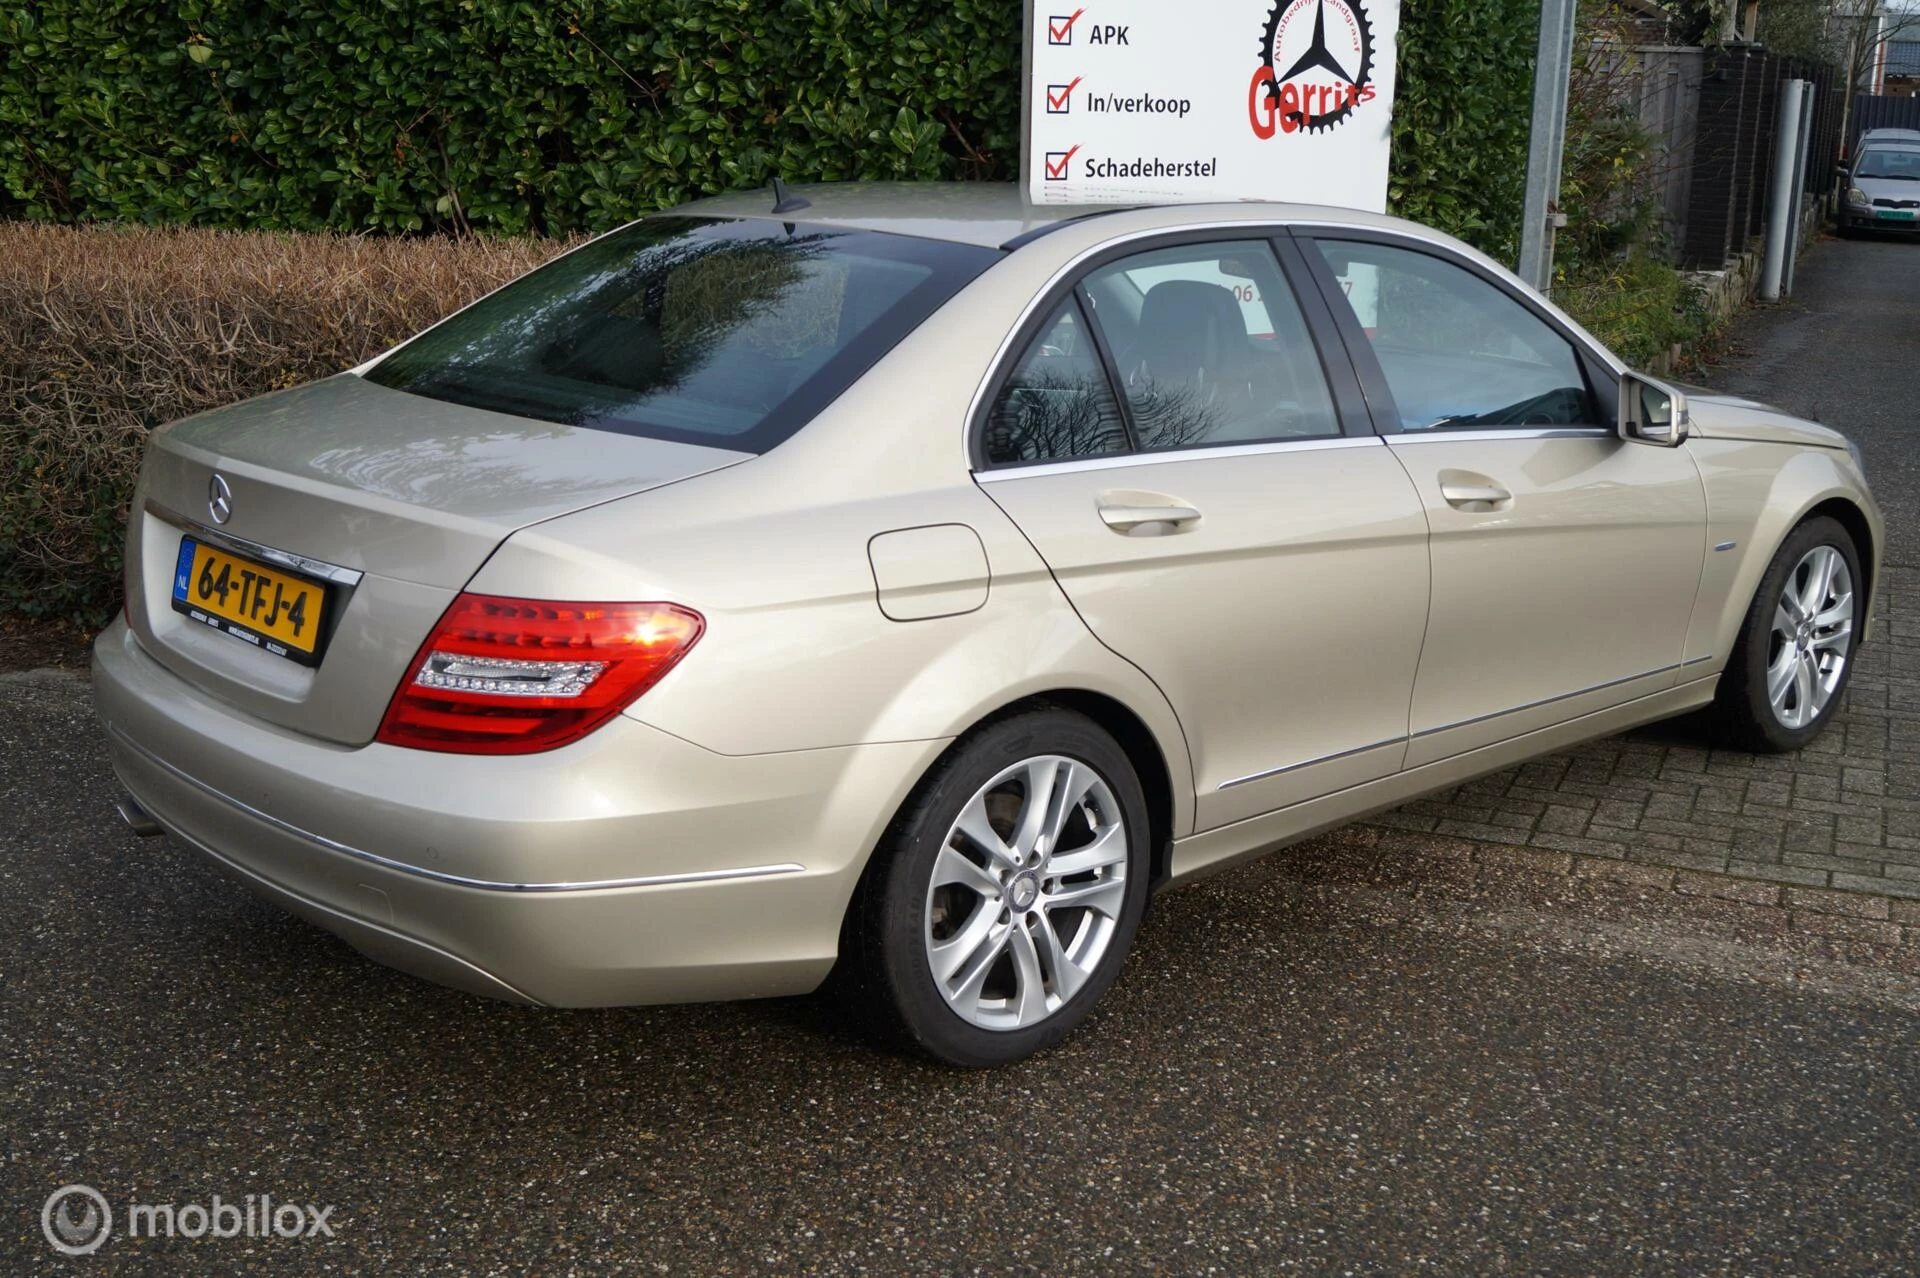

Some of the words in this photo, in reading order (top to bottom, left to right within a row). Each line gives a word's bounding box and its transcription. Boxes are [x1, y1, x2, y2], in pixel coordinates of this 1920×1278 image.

[1089, 25, 1129, 46] APK
[1274, 0, 1314, 62] Autobedrij
[1087, 92, 1191, 118] In/verkoop
[1248, 65, 1377, 140] Gerrits
[1085, 157, 1217, 178] Schadeherstel
[177, 574, 188, 590] NL
[197, 557, 308, 637] 64-TFJ-4
